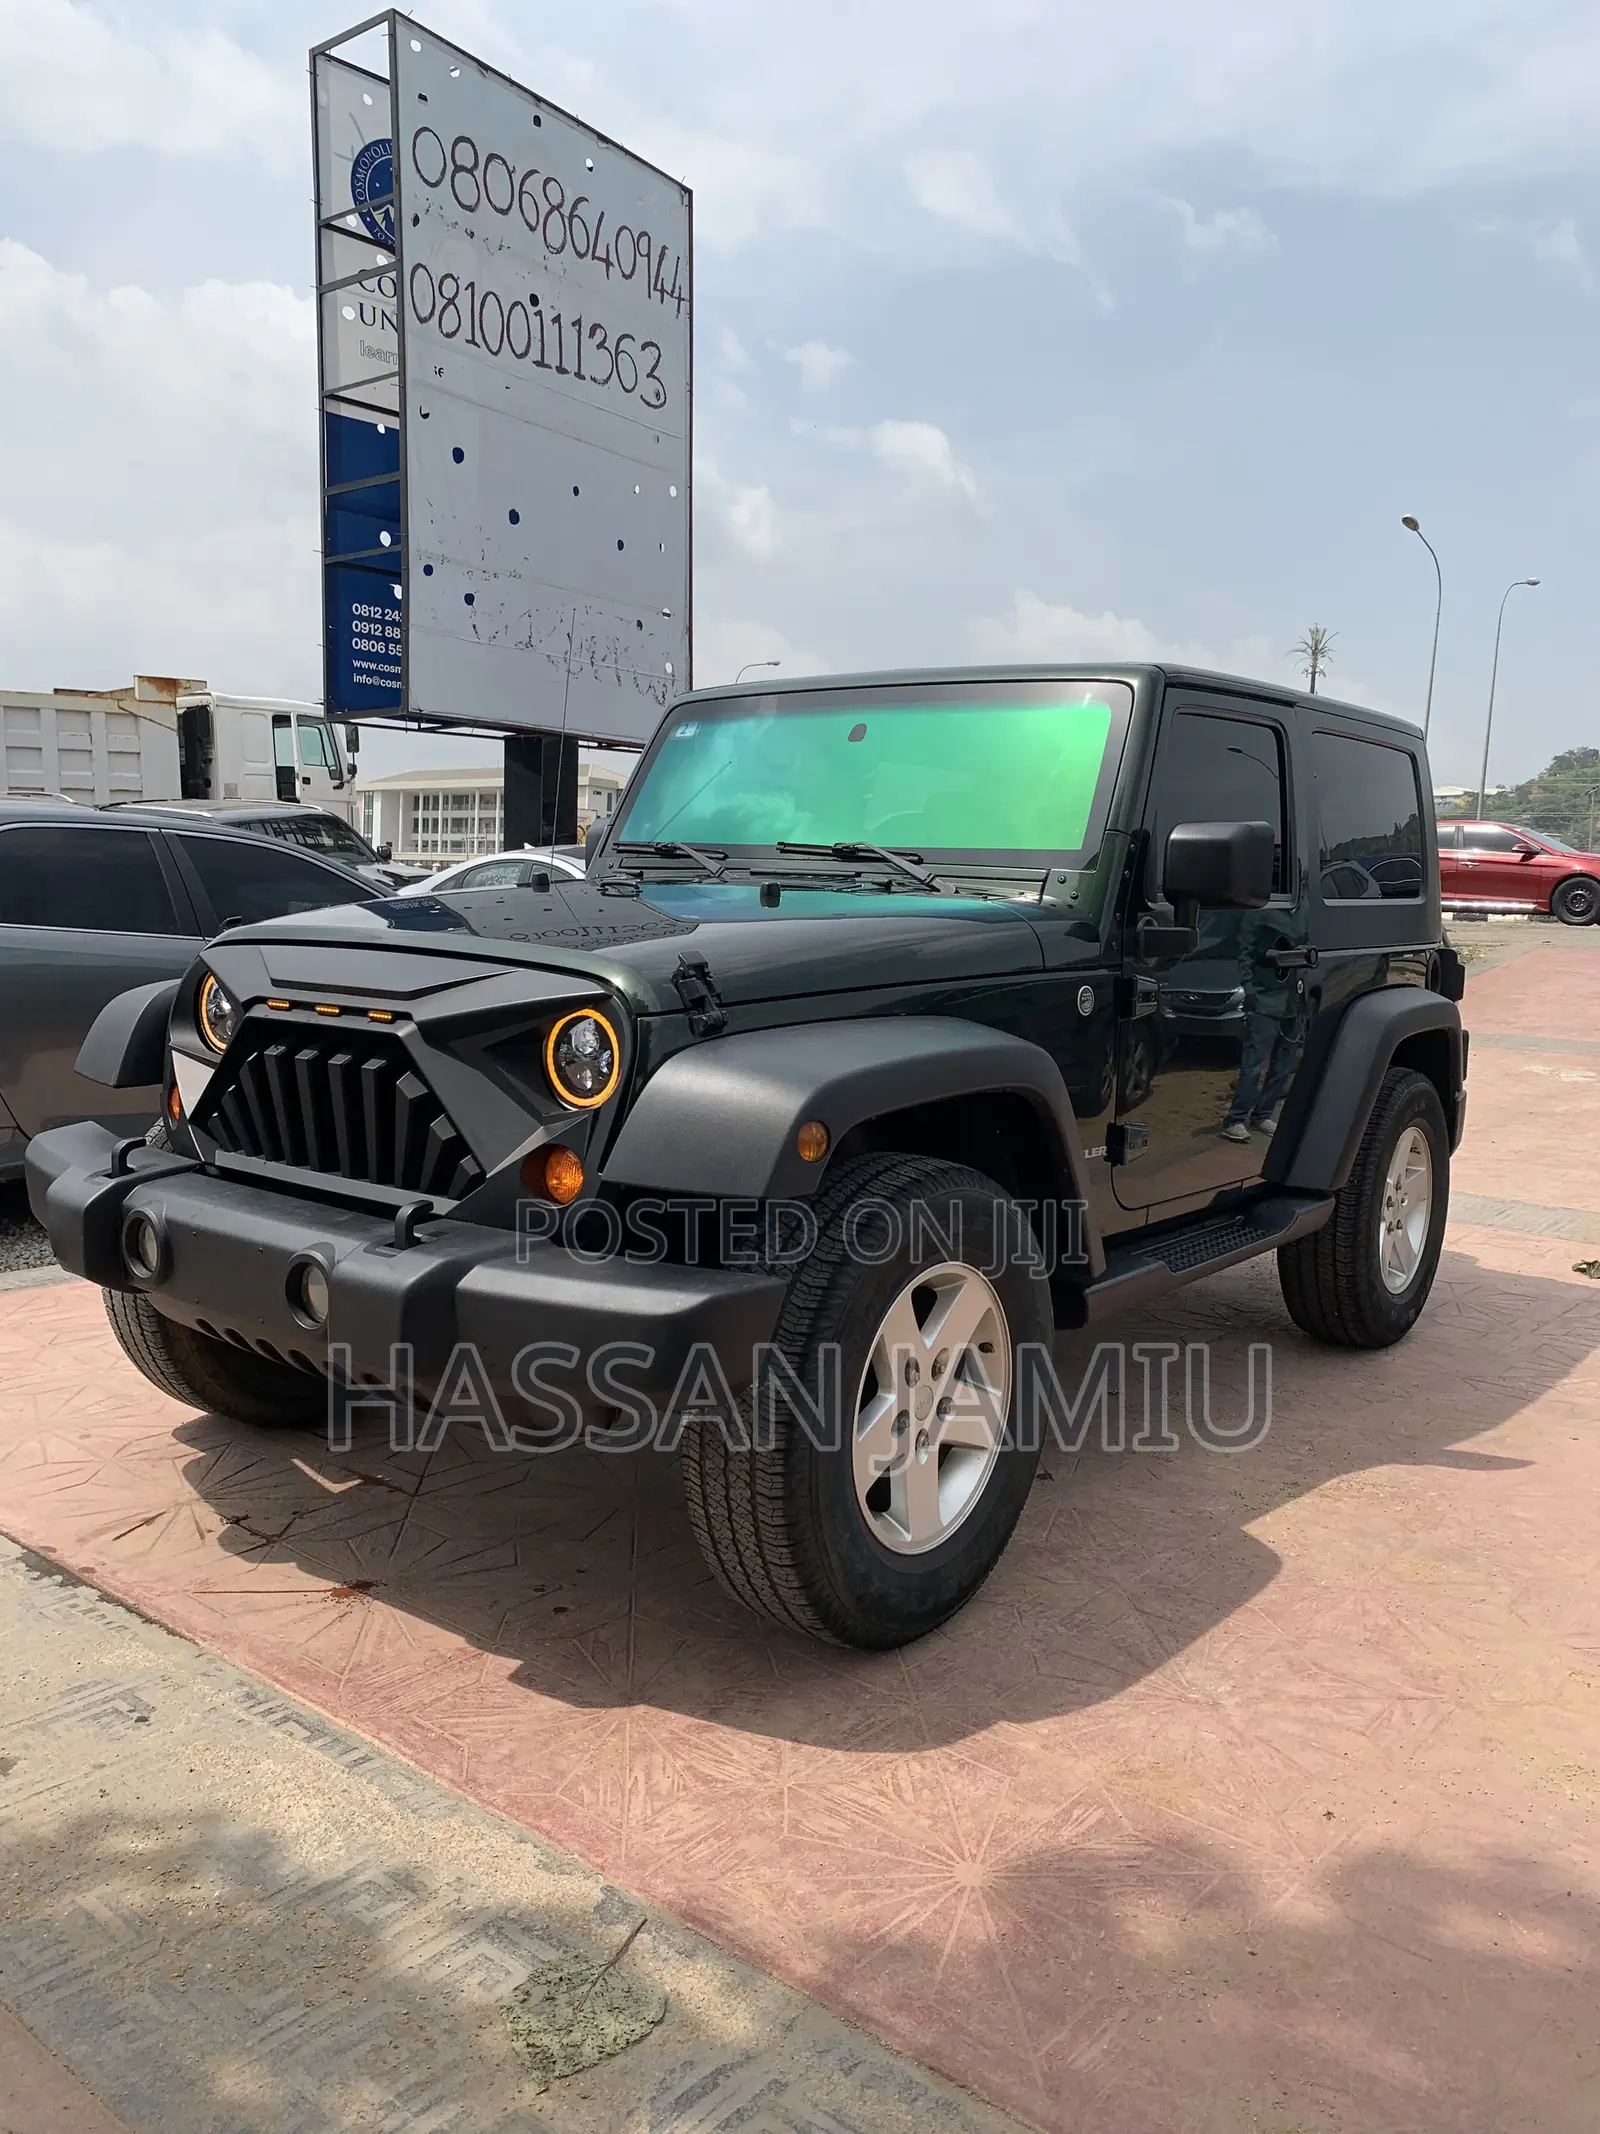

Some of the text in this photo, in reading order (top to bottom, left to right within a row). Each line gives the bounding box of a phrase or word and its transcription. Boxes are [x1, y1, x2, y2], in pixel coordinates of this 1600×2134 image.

[355, 142, 392, 212] OSMOPOLI
[412, 126, 690, 319] 08068640944
[410, 262, 667, 409] 08100111363
[352, 603, 382, 619] 0812
[352, 620, 401, 639] 0912 88
[352, 637, 402, 657] 0806 55
[1083, 1145, 1109, 1159] LER
